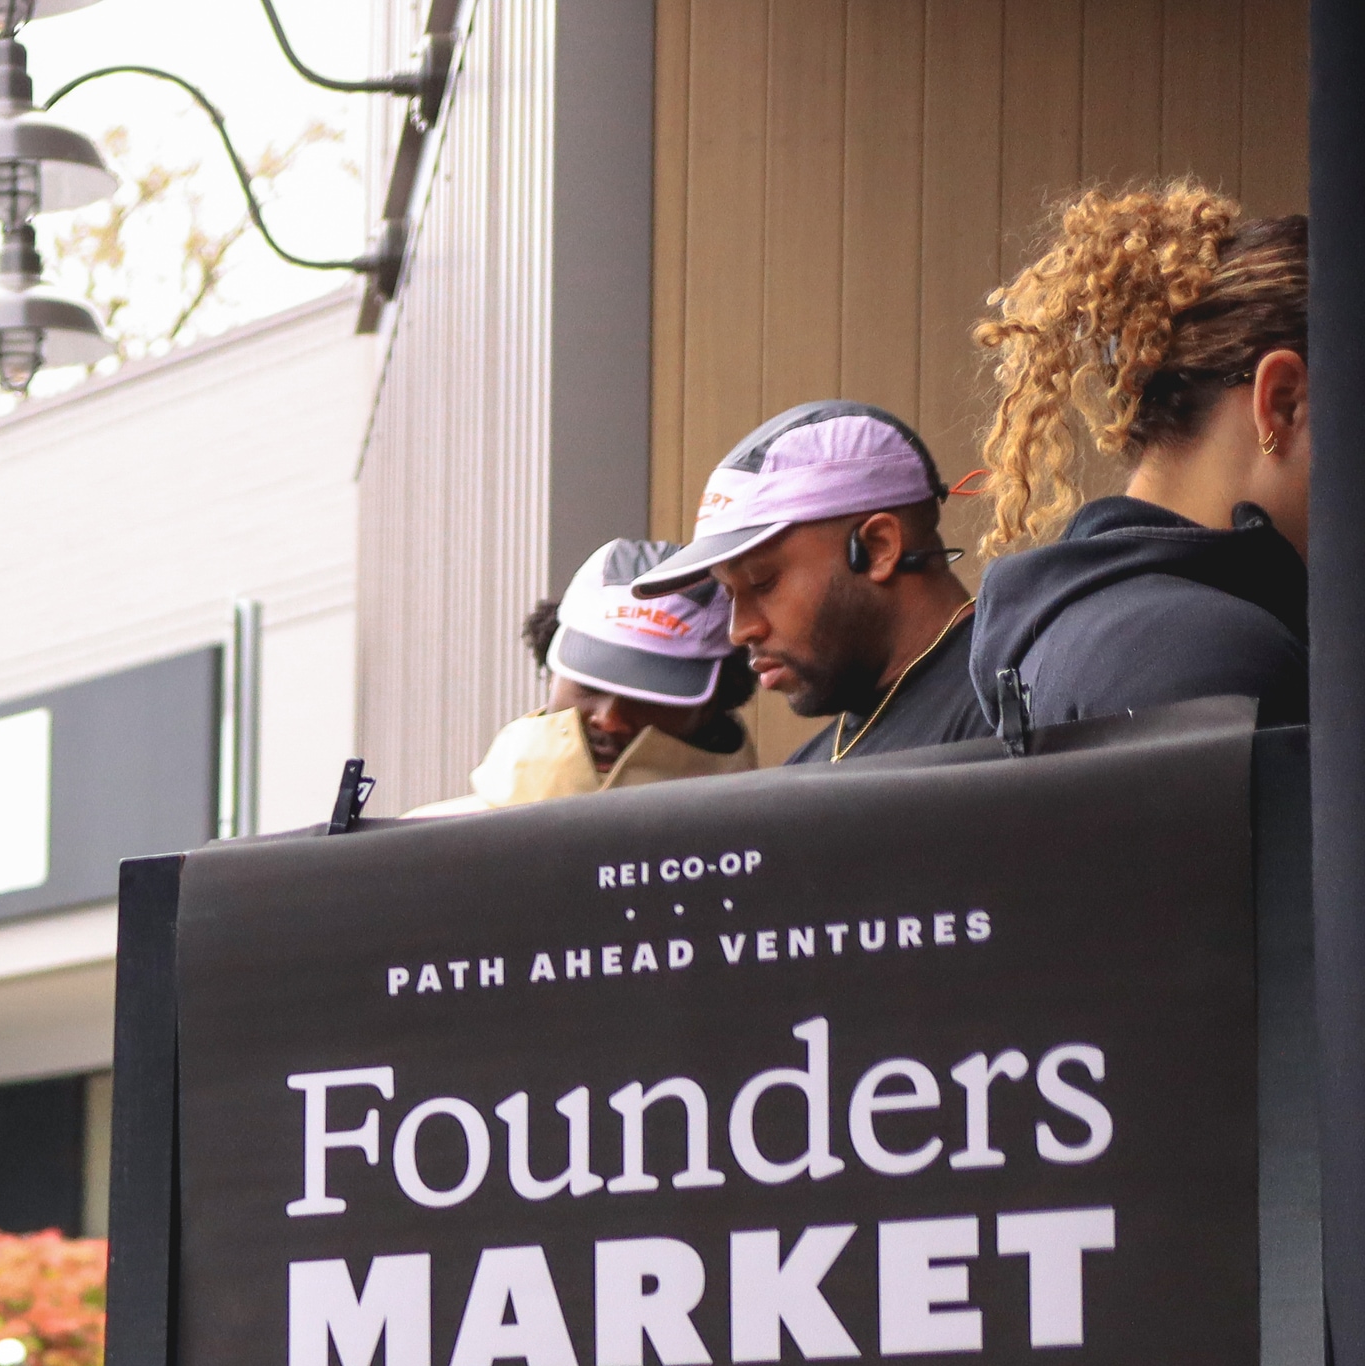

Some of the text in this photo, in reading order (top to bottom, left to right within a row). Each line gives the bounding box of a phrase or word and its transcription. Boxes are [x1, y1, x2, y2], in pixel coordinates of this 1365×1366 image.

[598, 850, 763, 888] REI CO-OP
[387, 909, 993, 996] PATH AHEAD VENTURES
[285, 1015, 1116, 1219] Founders
